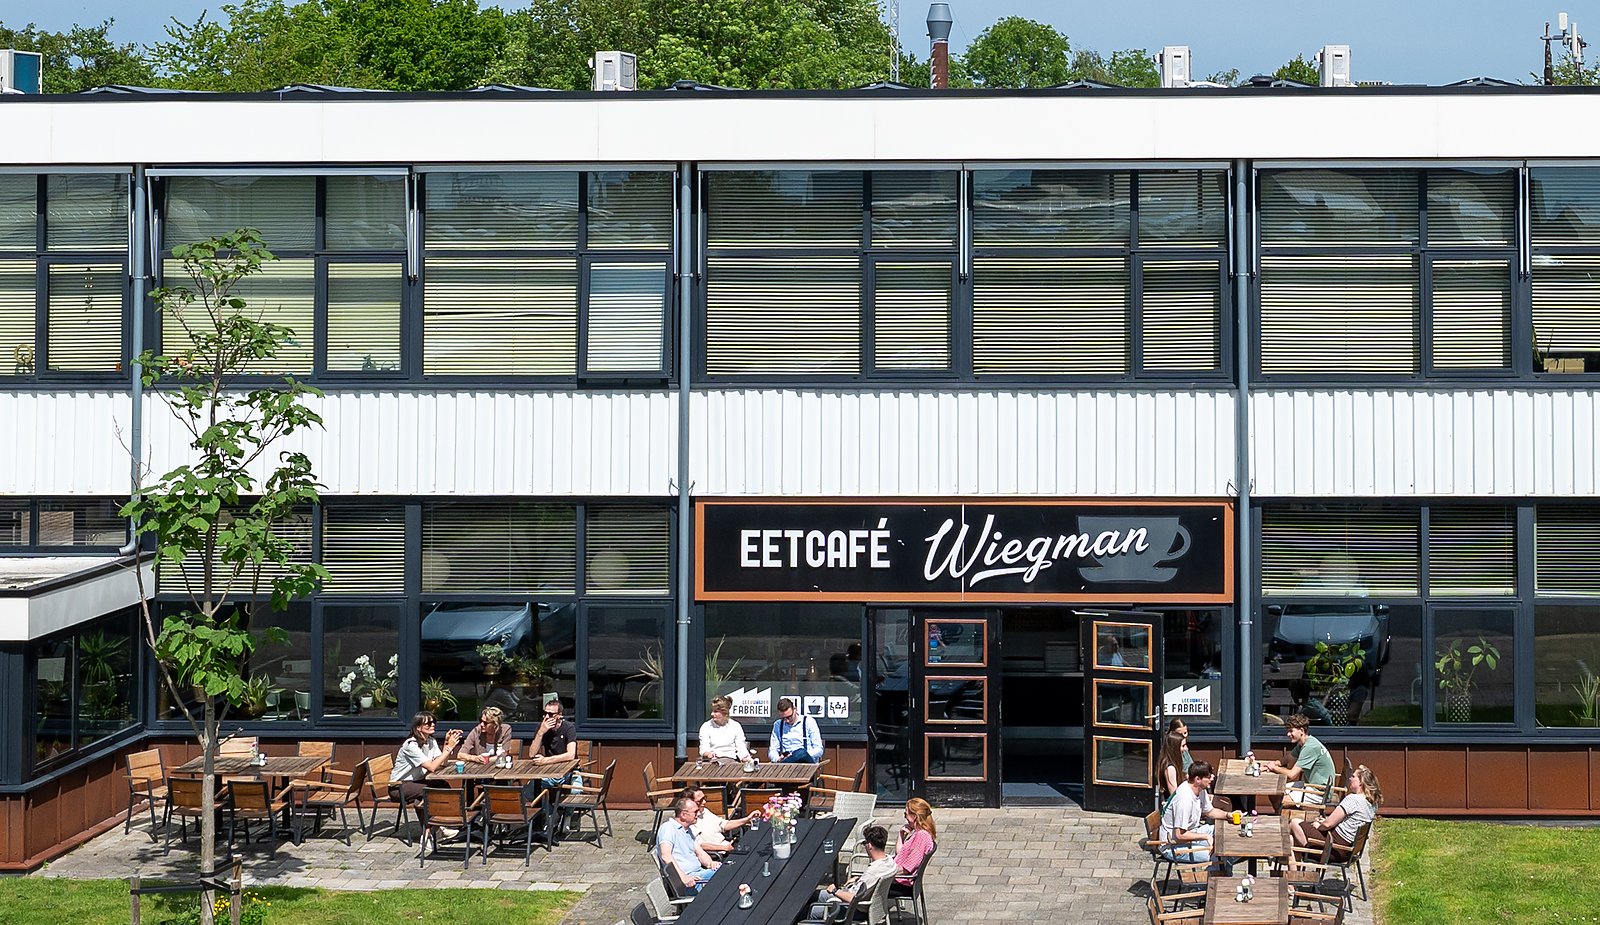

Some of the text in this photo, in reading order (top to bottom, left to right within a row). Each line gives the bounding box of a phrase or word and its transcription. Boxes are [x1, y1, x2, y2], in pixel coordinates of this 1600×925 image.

[740, 514, 1150, 588] EETCAFÉ Wiegman
[733, 706, 768, 714] FABRIEK
[1172, 704, 1208, 712] FABRIEK
